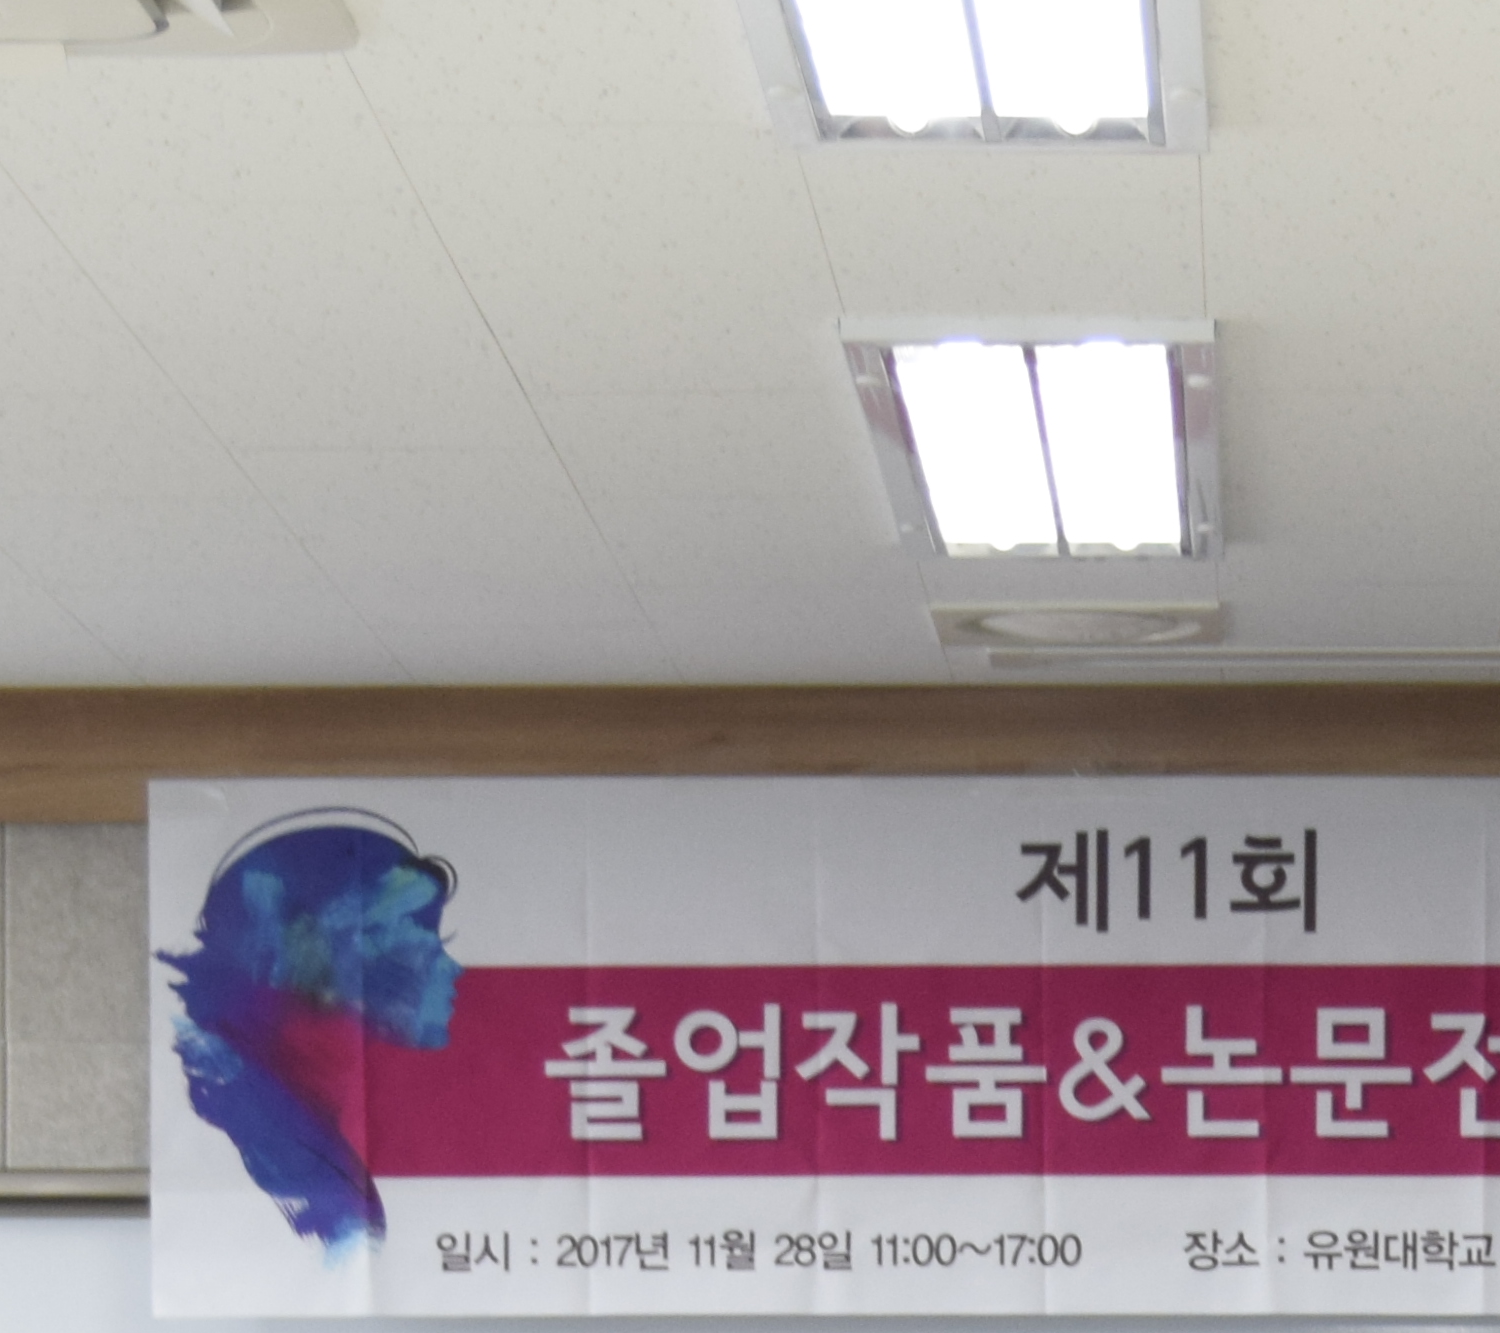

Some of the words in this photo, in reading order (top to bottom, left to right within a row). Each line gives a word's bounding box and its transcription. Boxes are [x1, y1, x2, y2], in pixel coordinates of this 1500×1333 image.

[1015, 827, 1318, 933] 제11회
[435, 1231, 510, 1273] 일시
[555, 1230, 669, 1272] 2017년
[688, 1229, 756, 1271] 11월
[773, 1229, 853, 1271] 28일
[870, 1231, 1083, 1268] 11:00~17:00
[1183, 1229, 1260, 1272] 장소
[1302, 1229, 1497, 1273] 유원대학교
